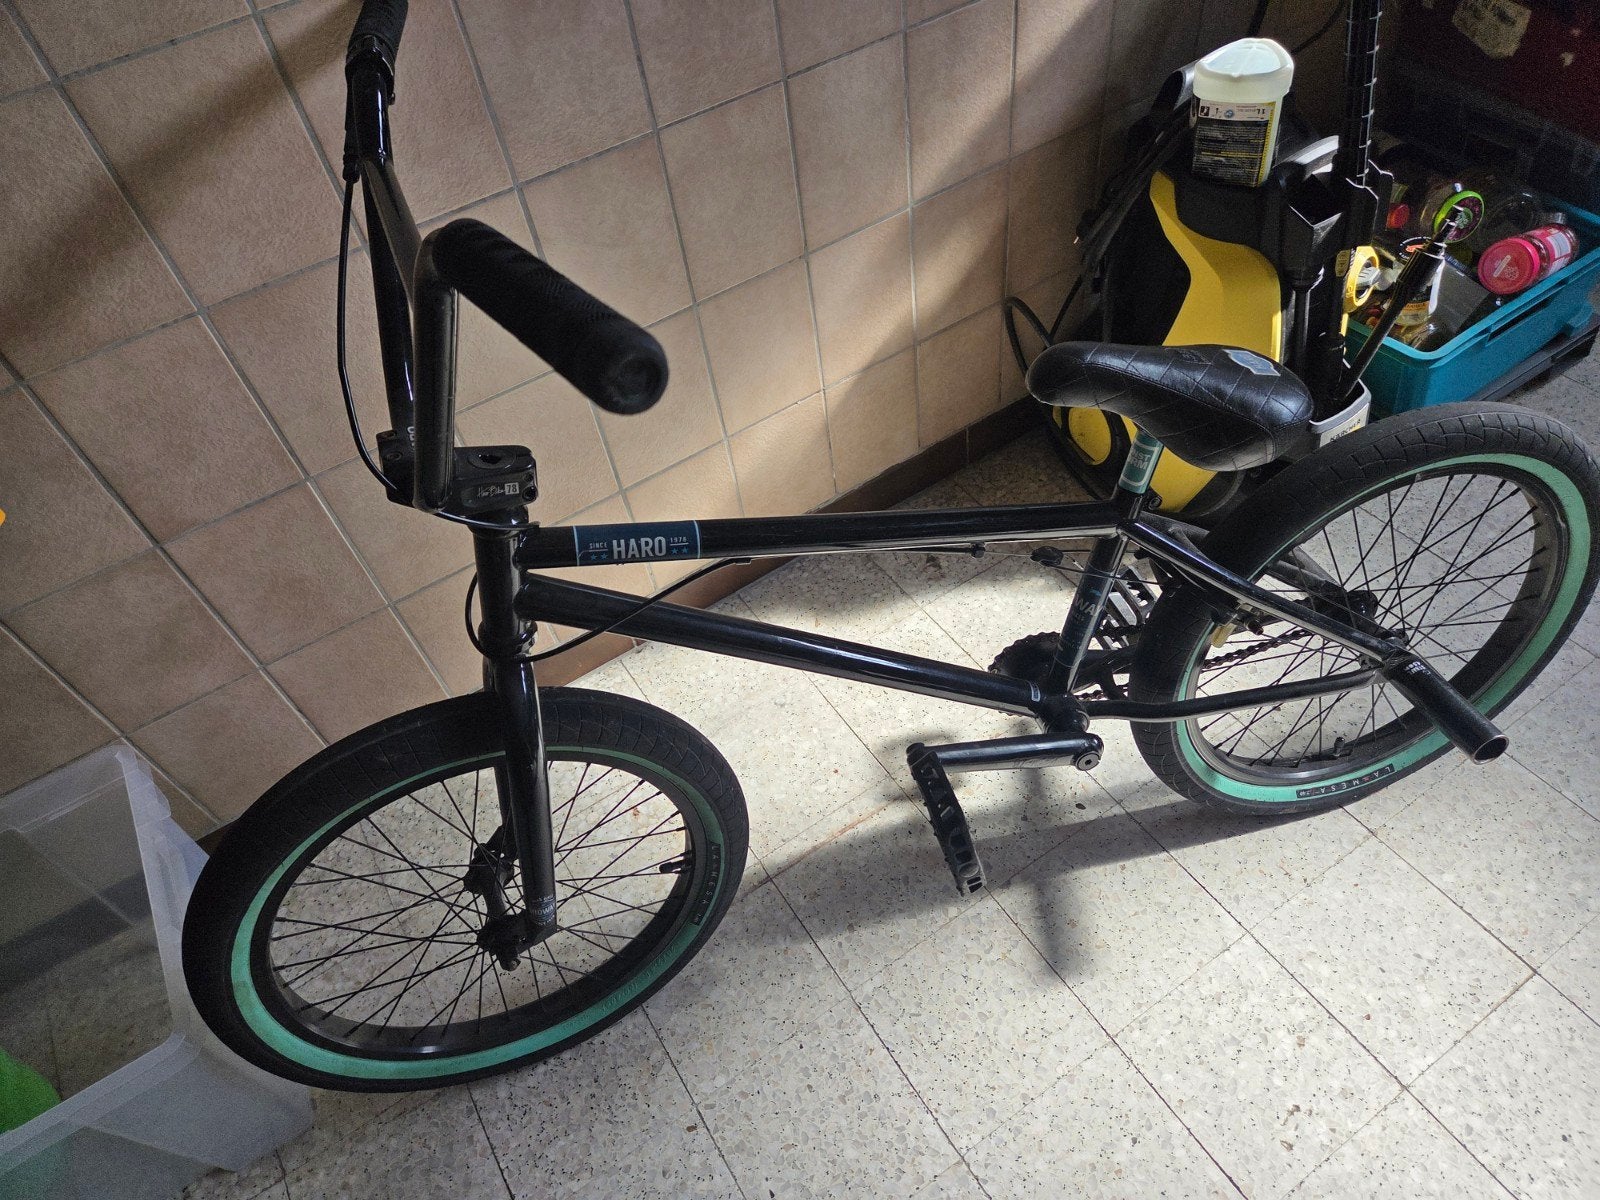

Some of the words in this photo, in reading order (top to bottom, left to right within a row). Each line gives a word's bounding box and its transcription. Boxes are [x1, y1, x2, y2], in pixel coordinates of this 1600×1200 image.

[506, 484, 517, 494] 78
[589, 541, 608, 549] SINCE
[612, 536, 667, 560] HARO
[1373, 765, 1391, 778] LA
[1320, 778, 1360, 794] MESA
